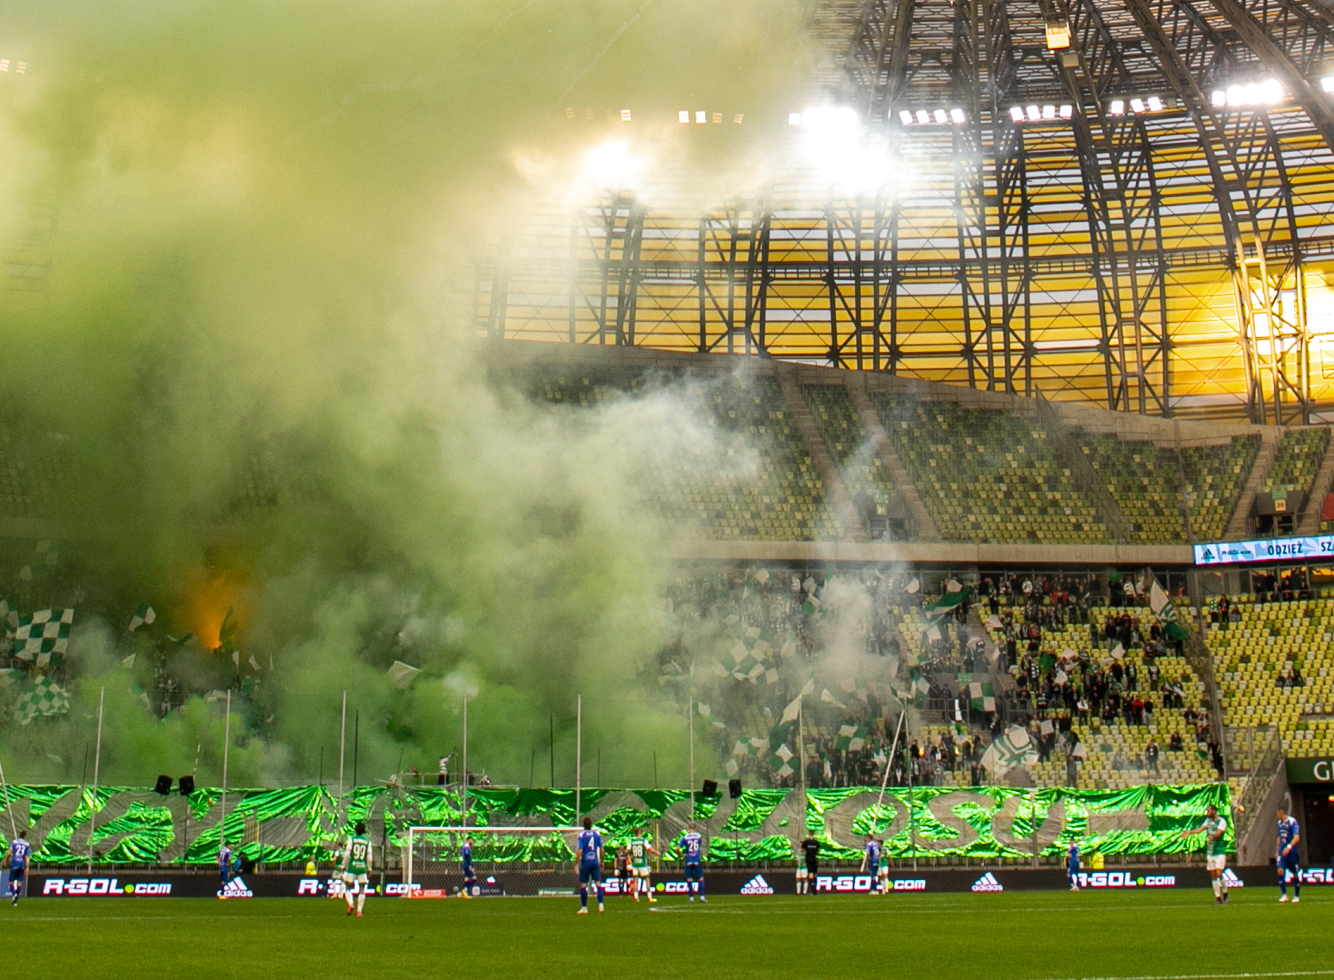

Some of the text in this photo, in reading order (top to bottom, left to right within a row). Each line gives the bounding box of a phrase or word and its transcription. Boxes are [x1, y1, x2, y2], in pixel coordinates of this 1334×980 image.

[1267, 542, 1303, 557] ODZIEŻ
[588, 838, 595, 851] 4
[687, 839, 699, 852] 26
[740, 886, 774, 895] adidas
[971, 883, 1004, 893] adidas
